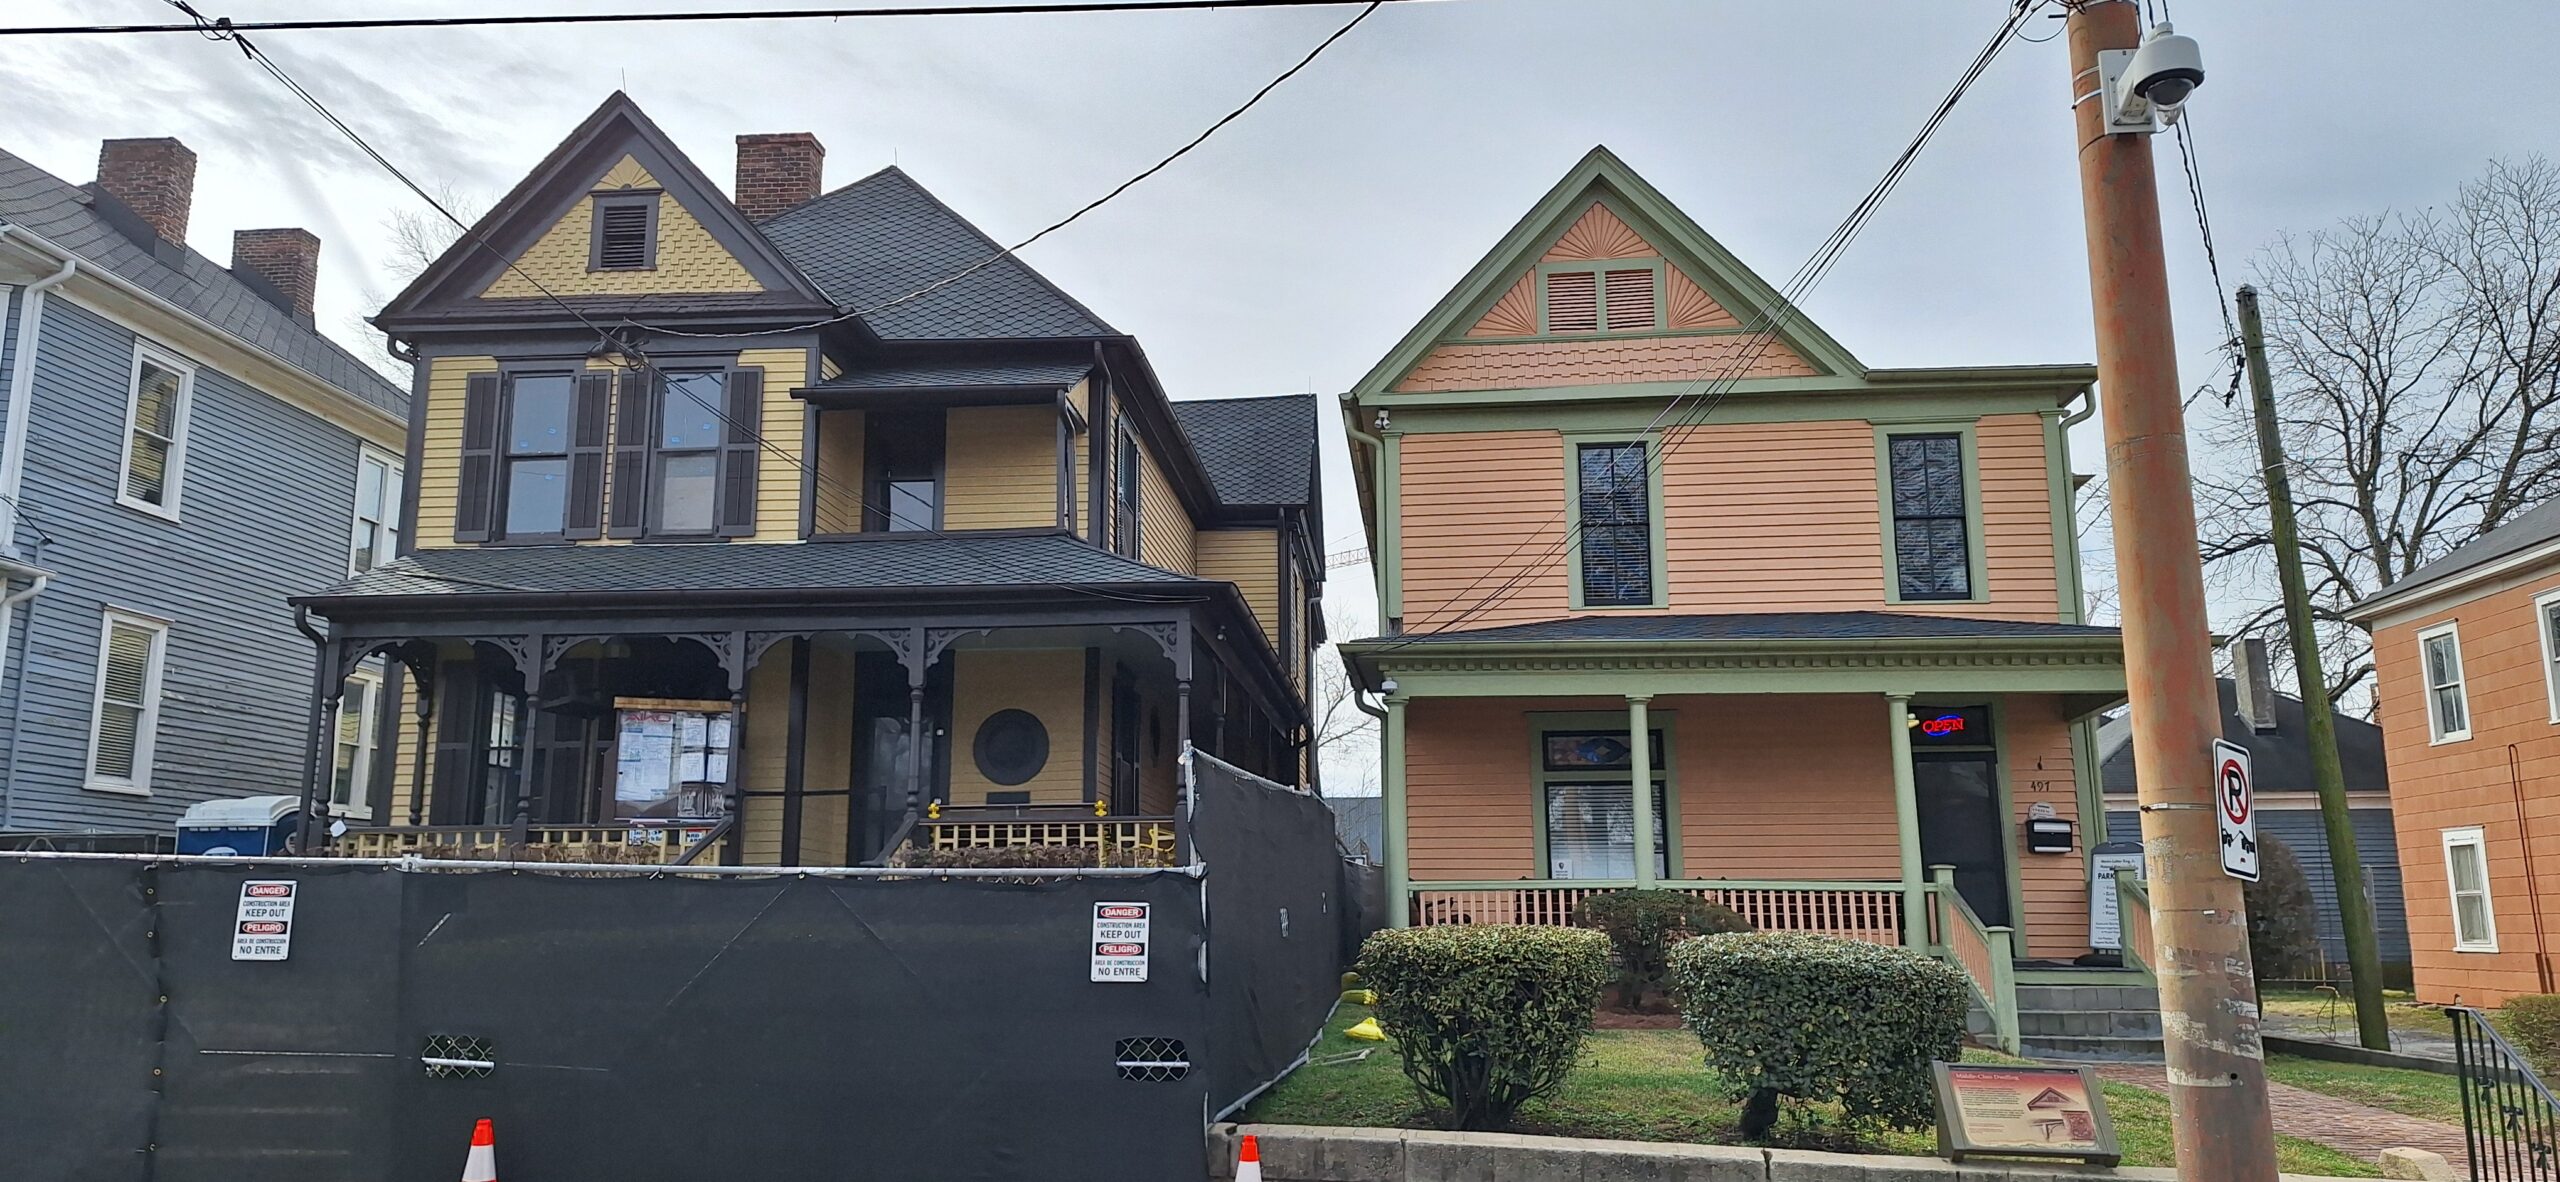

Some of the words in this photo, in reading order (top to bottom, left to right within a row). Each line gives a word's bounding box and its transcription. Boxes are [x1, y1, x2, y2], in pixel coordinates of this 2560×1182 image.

[1922, 717, 1965, 733] OPEN
[252, 886, 285, 895] DANGER
[245, 909, 267, 917] KEEP
[269, 909, 285, 917] OUT
[247, 924, 282, 932] PELIGRO
[1100, 930, 1122, 938] KEEP
[1124, 930, 1141, 938] OUT
[239, 946, 252, 954] NO
[255, 946, 282, 954] ENTRE
[1103, 945, 1138, 953] PELIGRO
